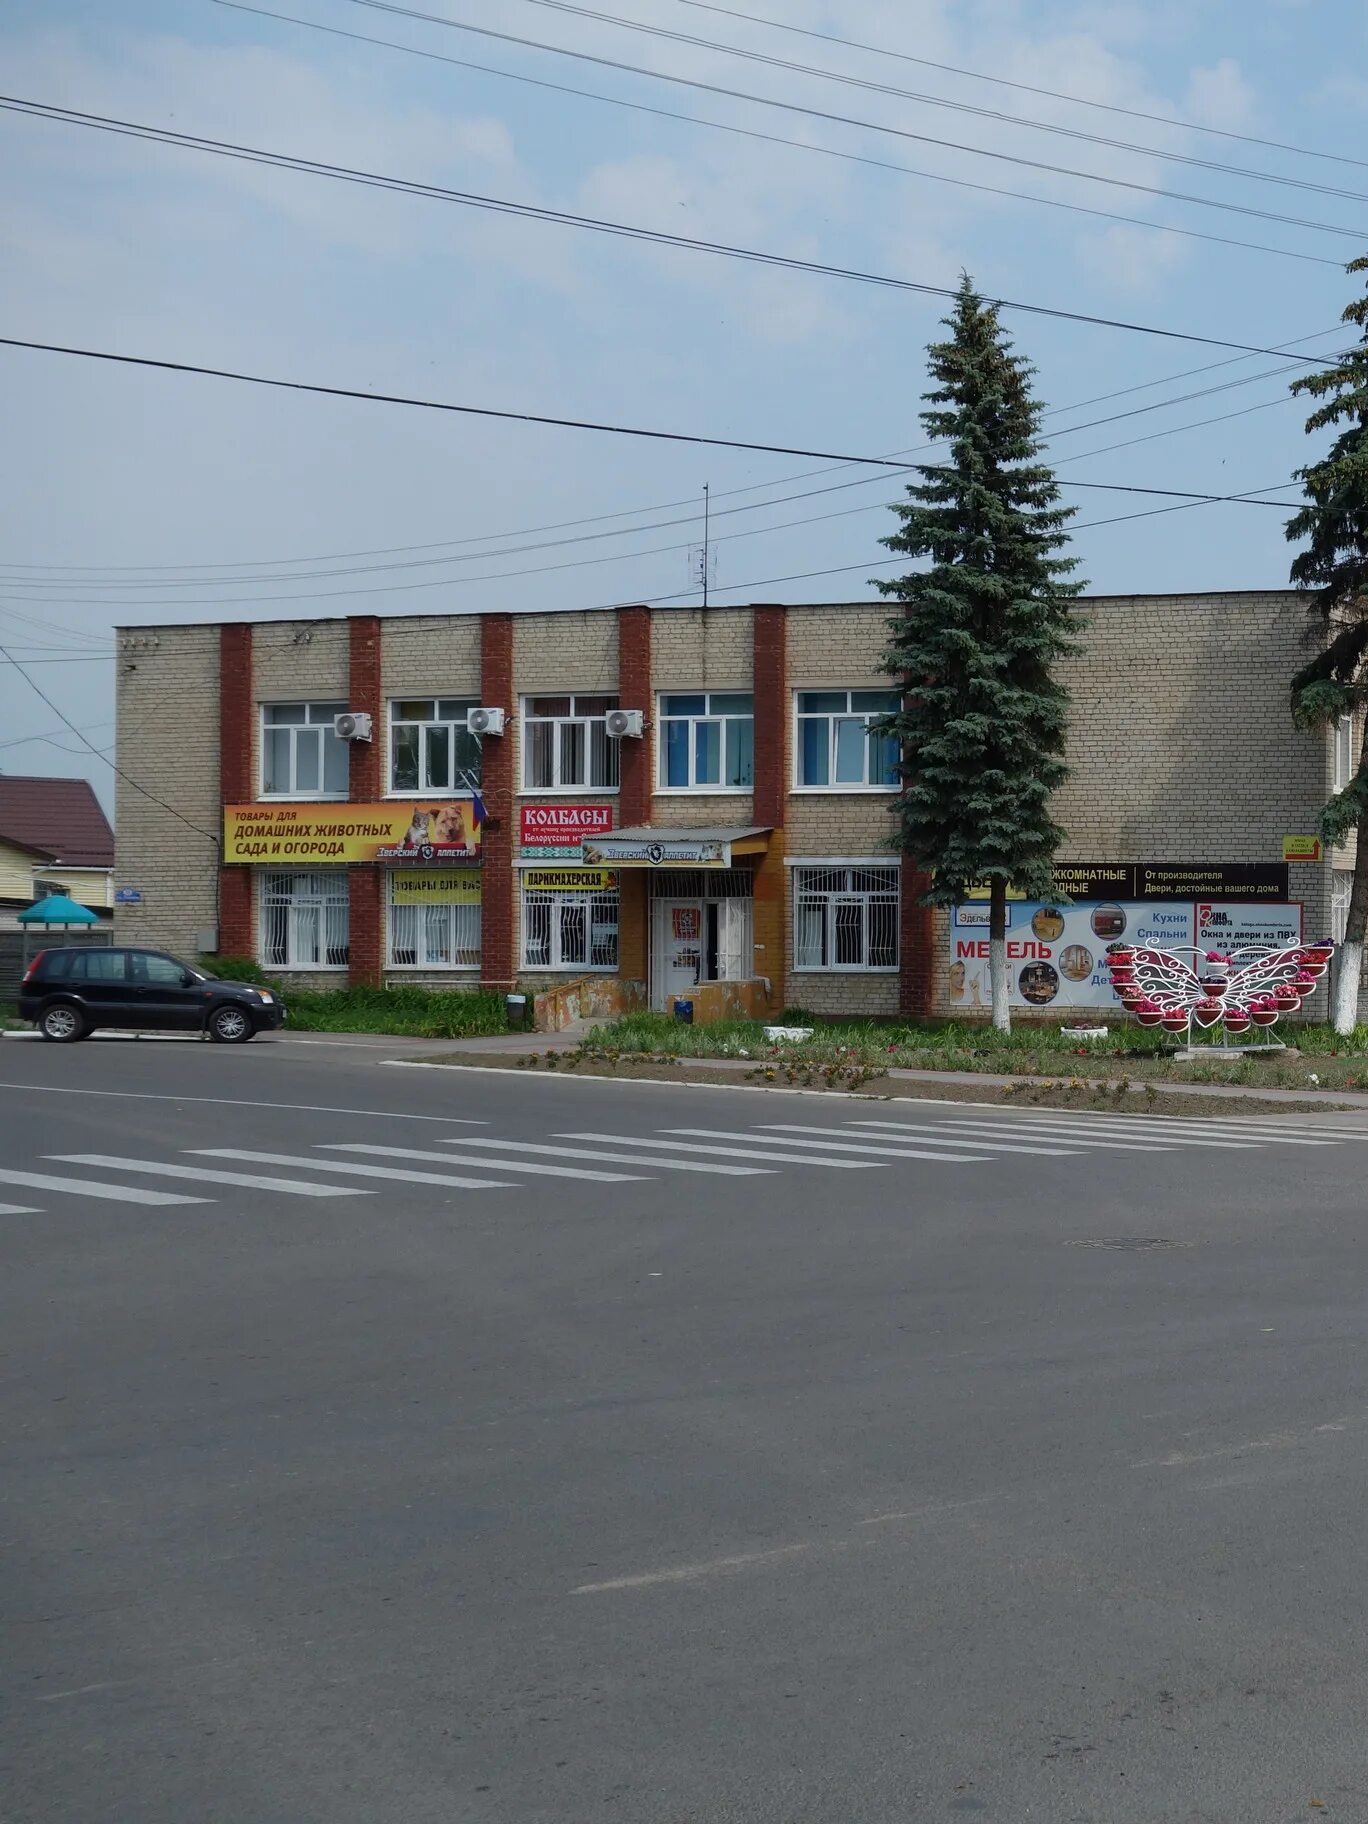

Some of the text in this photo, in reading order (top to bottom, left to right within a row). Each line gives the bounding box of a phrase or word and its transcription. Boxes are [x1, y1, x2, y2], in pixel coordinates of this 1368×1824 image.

[235, 811, 297, 821] ТОВАРЫ ДЛЯ
[524, 809, 608, 825] КОЛБАСЫ
[234, 823, 392, 839] ДОМАШНИХ ЖИВОТНЫХ
[524, 833, 570, 844] Белоруссии
[235, 841, 345, 857] САДА И ОГОРОДА
[528, 872, 602, 886] ПАРИКМАХЕРСКАЯ
[1051, 869, 1126, 880] ЖКОМНАТНЫЕ
[1145, 870, 1223, 882] От производителя
[1144, 882, 1280, 895] Двери, достойные вашего дома
[1152, 913, 1187, 924] Кухни
[1137, 928, 1187, 939] Спальни
[1200, 929, 1224, 938] Окна
[1234, 931, 1261, 940] двери
[1264, 931, 1275, 939] из
[1277, 931, 1297, 940] ПВХ
[956, 941, 1052, 959] МЕЕЛЬ
